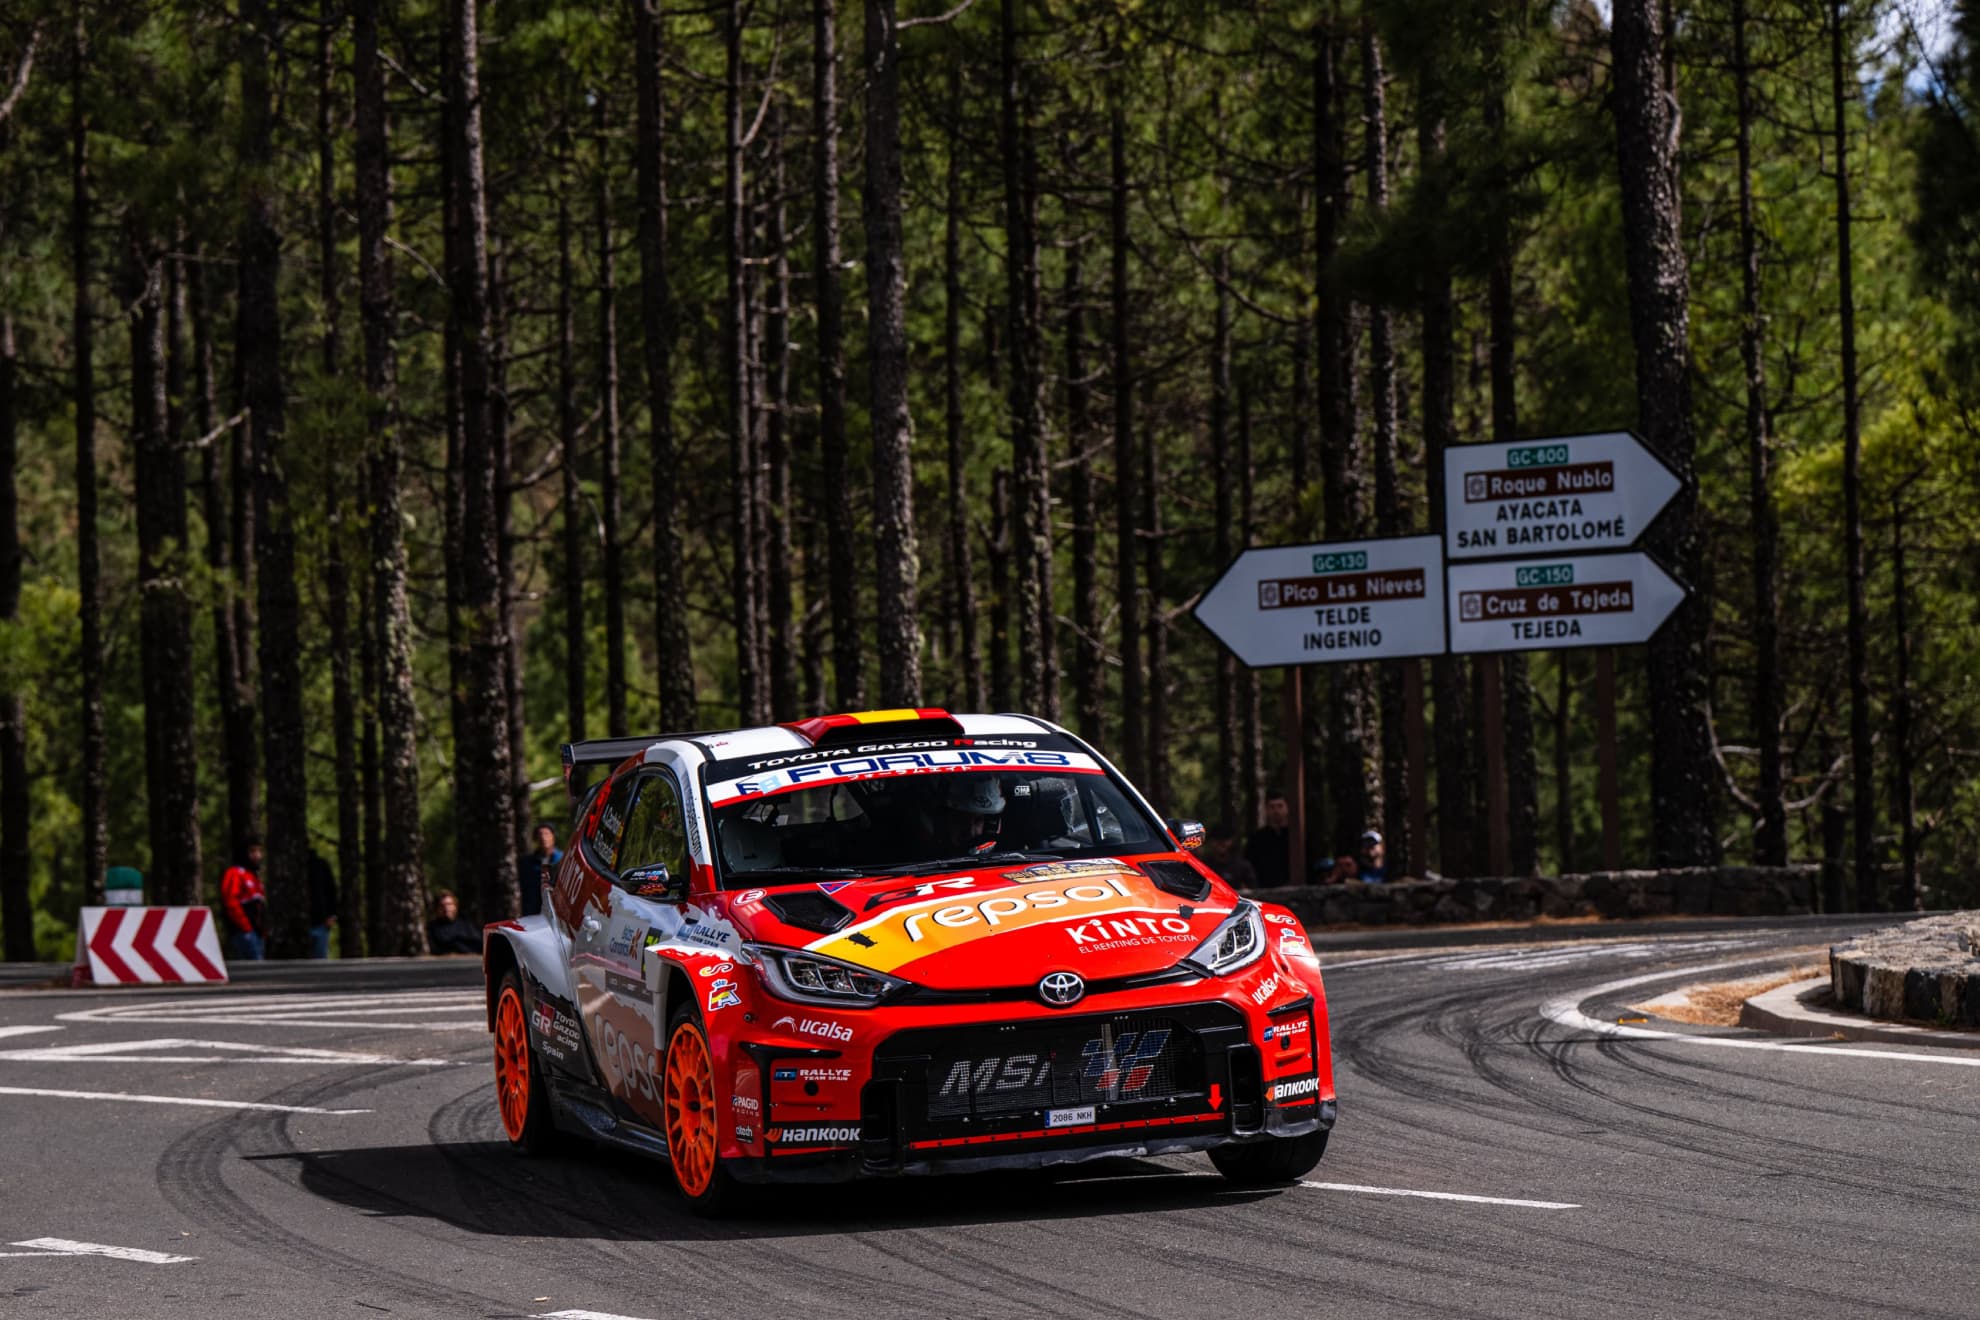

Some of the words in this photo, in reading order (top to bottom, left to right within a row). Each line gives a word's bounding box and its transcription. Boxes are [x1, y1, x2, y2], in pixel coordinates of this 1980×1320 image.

[1509, 448, 1567, 465] GC-600
[1491, 475, 1547, 495] Roque
[1557, 468, 1612, 490] Nublo
[1496, 498, 1583, 522] AYACATA
[1457, 528, 1497, 548] SAN
[1507, 515, 1625, 545] BARTOLOMÉ
[1314, 553, 1366, 571] GC-130
[1517, 566, 1572, 585] GC-150
[1283, 583, 1319, 602] Pico
[1327, 580, 1358, 599] Las
[1366, 576, 1424, 597] Nieves
[1486, 596, 1527, 614] Cruz
[1537, 593, 1560, 611] de
[1570, 588, 1631, 612] Tejeda
[1314, 606, 1371, 626] TELDE
[1303, 628, 1382, 651] INGENIO
[1511, 618, 1583, 640] TEJEDA
[747, 749, 851, 770] TOYOTA
[857, 740, 949, 753] GAZOO
[953, 738, 1038, 748] Racing
[787, 750, 1070, 783] FORUM8
[903, 878, 1132, 942] repsol
[693, 924, 731, 943] RALLYE
[1064, 917, 1191, 945] KINTO
[1078, 945, 1094, 954] EL
[1094, 937, 1141, 952] RENTING
[1140, 936, 1155, 945] DE
[1155, 934, 1199, 943] TOYOTA
[1252, 978, 1278, 1005] ucalsa
[531, 1009, 552, 1037] GR
[799, 1018, 853, 1042] ucalsa
[1273, 1020, 1309, 1033] RALLYE
[542, 1041, 564, 1061] Spain
[799, 1069, 852, 1077] RALLYE
[738, 1096, 759, 1110] PAGID
[1076, 1111, 1093, 1121] NKH
